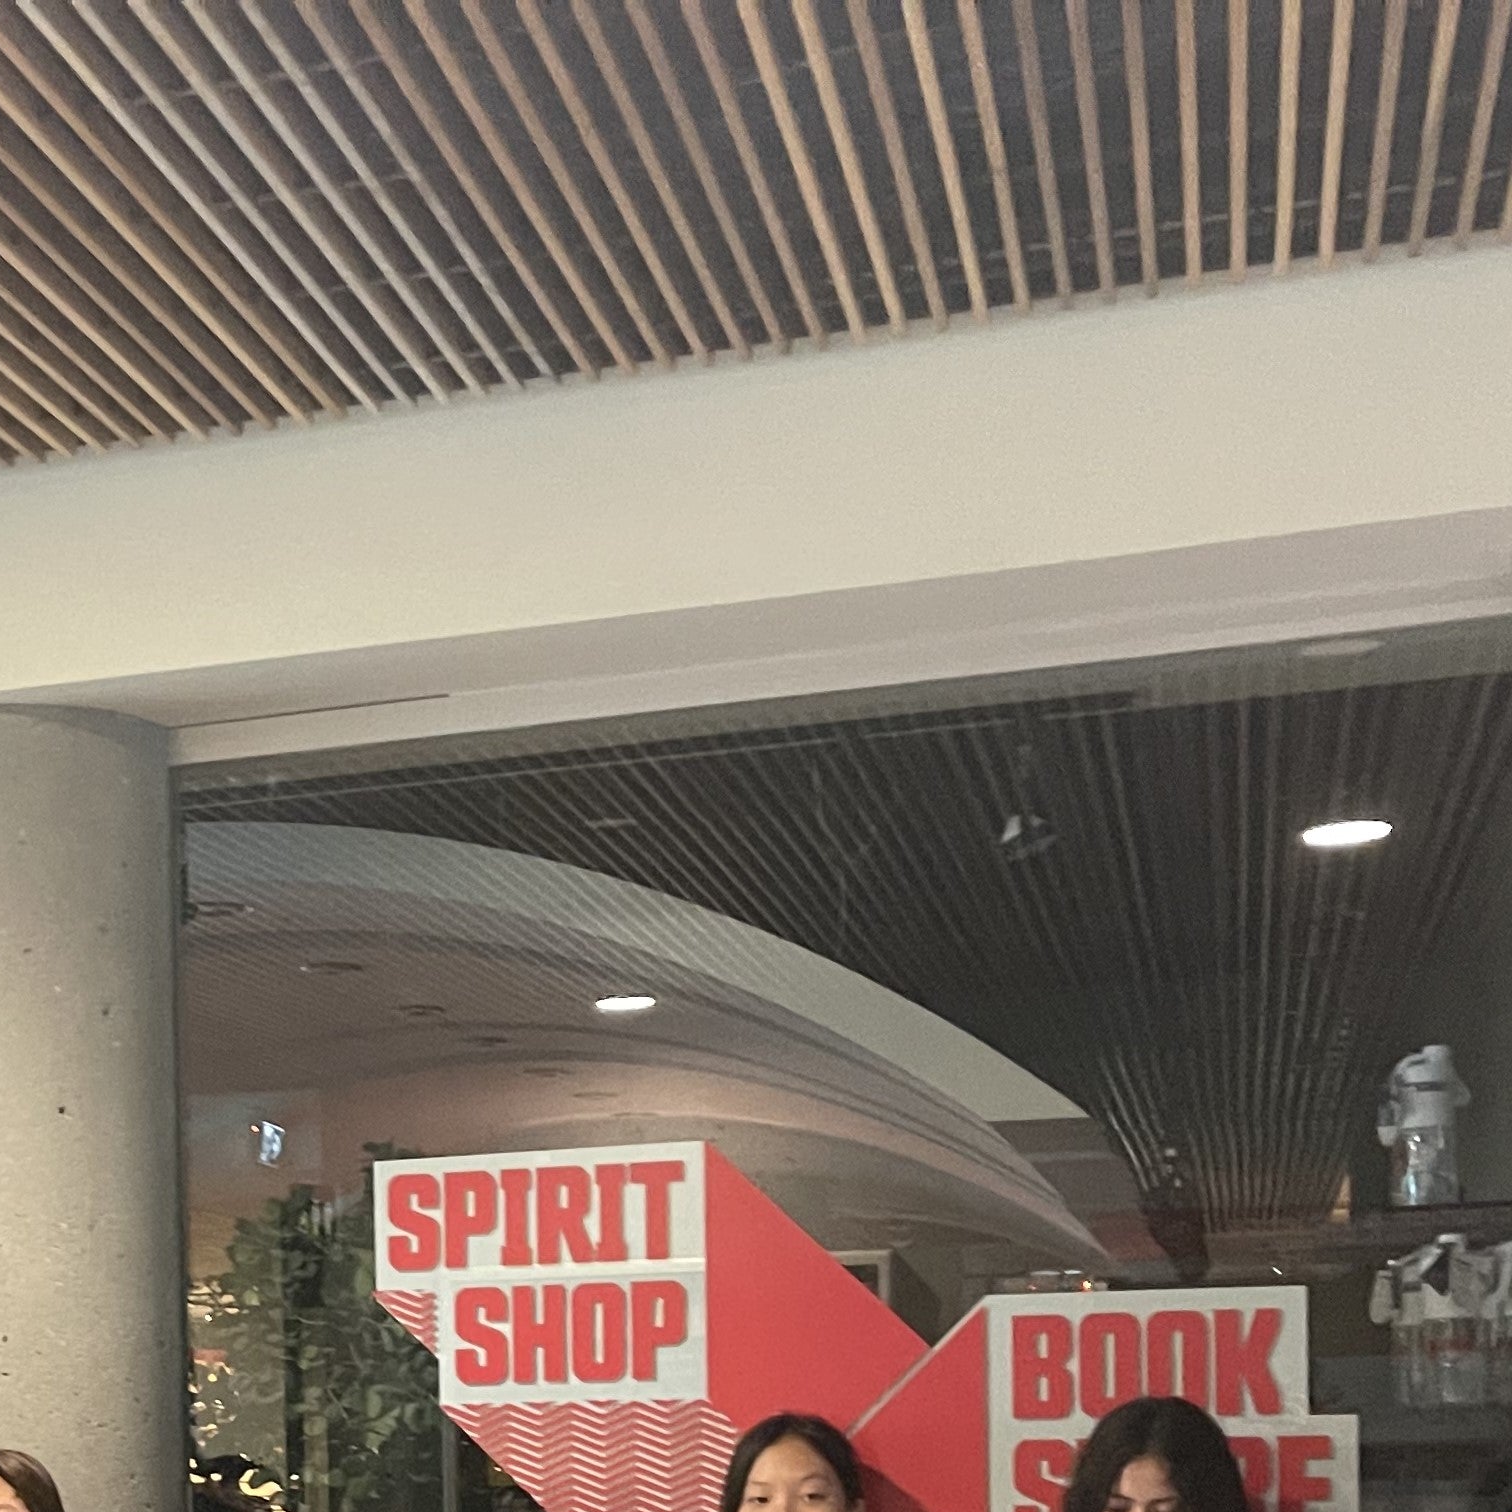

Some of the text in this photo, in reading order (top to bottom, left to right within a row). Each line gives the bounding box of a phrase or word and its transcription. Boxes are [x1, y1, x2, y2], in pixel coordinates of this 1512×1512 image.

[387, 1159, 686, 1272] SPIRIT
[453, 1279, 688, 1387] SHOP
[1011, 1307, 1284, 1421] BOOK
